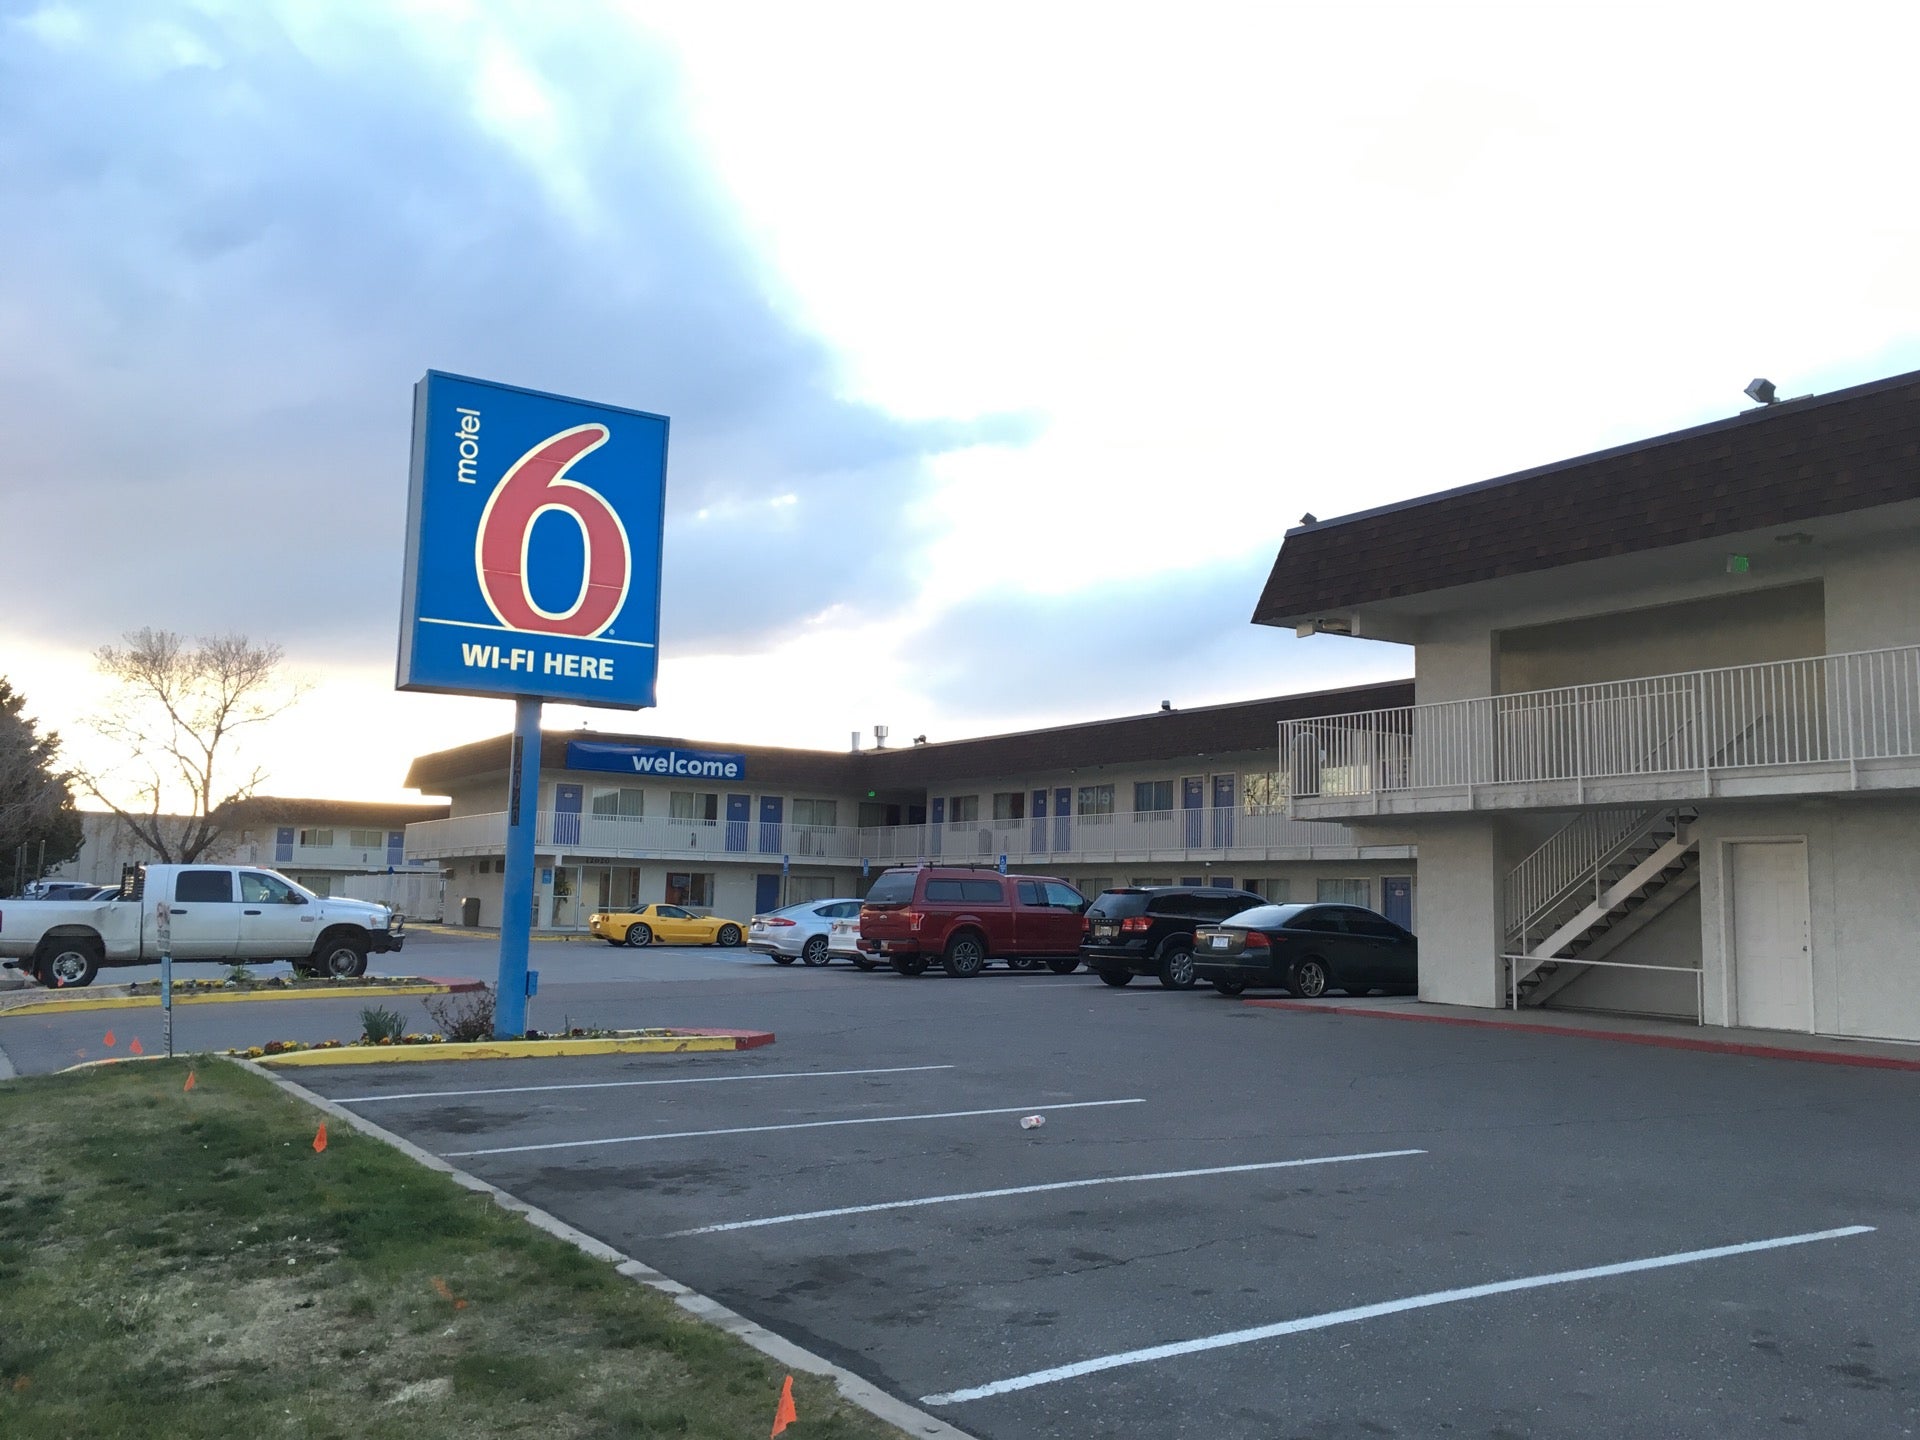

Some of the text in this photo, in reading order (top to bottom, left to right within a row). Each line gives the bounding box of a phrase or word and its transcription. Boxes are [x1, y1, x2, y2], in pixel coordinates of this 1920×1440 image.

[455, 407, 480, 484] motel
[475, 423, 631, 639] 6
[462, 643, 614, 681] WI-FI HERE
[632, 751, 738, 777] welcome
